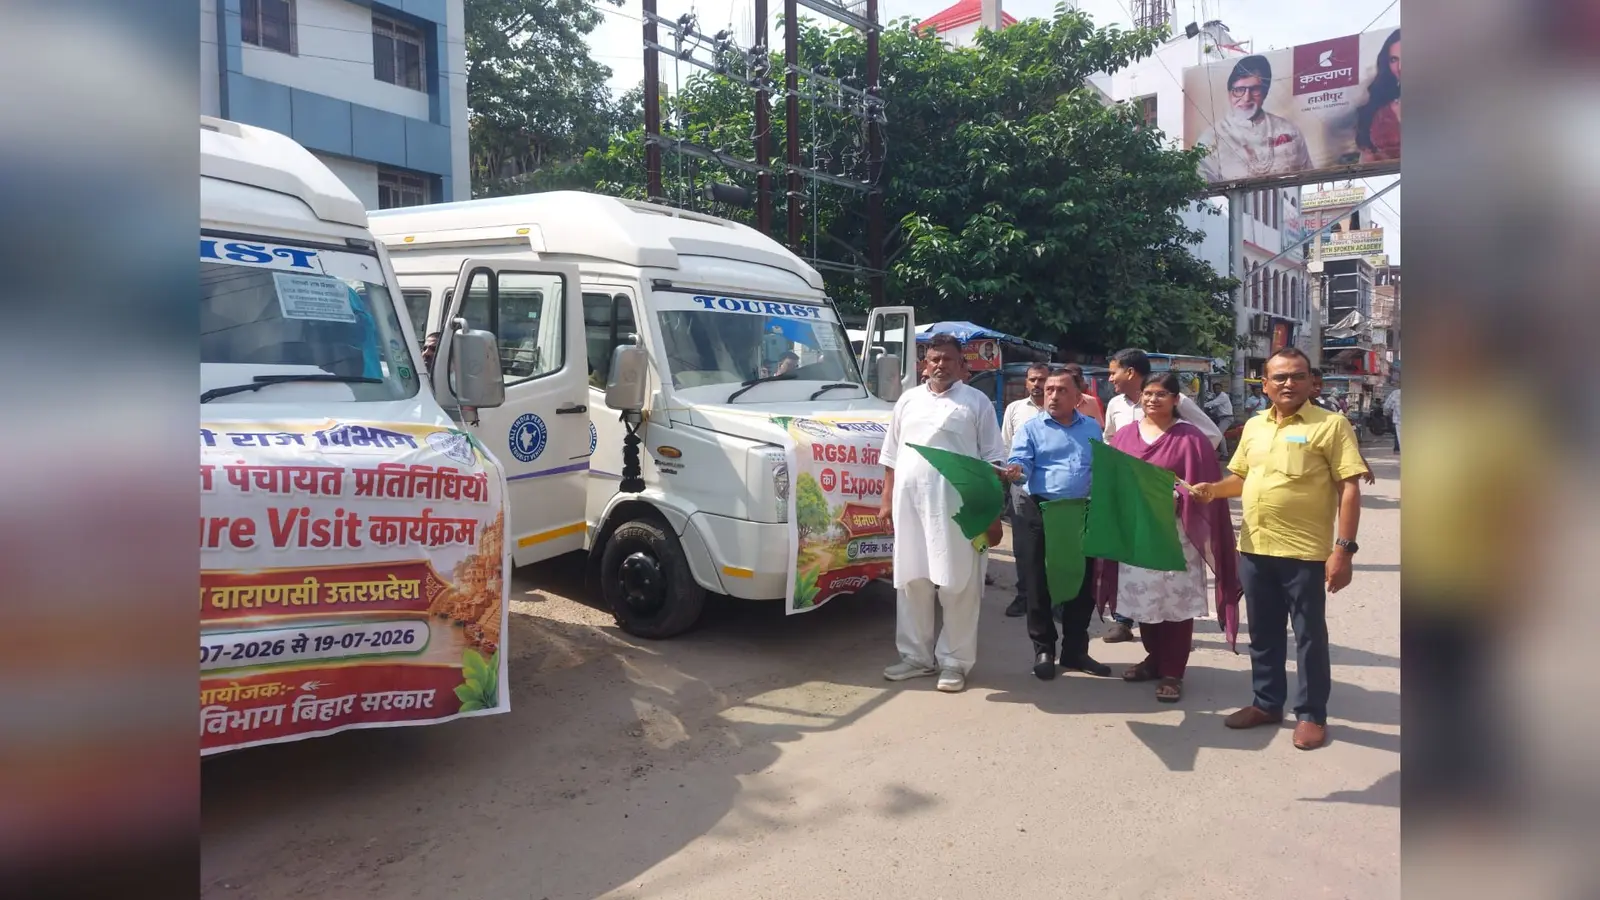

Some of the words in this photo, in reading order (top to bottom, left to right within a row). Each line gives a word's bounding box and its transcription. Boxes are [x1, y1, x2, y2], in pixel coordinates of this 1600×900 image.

[1300, 67, 1352, 84] कल्याण
[1356, 242, 1382, 251] ACADEMY
[694, 296, 820, 319] TOURIST
[226, 431, 304, 447] राज
[312, 425, 418, 449] विभाग
[509, 428, 517, 440] ALL
[514, 415, 530, 427] INDIA
[531, 415, 547, 436] PERMIT
[811, 443, 858, 464] RGSA
[861, 443, 881, 465] अंत
[223, 460, 345, 496] पंचायत
[841, 470, 885, 500] Expos
[267, 507, 362, 548] Visit
[368, 508, 478, 547] कार्यक्रम
[881, 543, 894, 553] 16-0
[211, 577, 320, 609] वाराणसी
[324, 574, 421, 604] उत्तरप्रदेश
[291, 633, 309, 653] से
[314, 629, 415, 651] 19-07-2026
[200, 704, 287, 737] विभाग
[292, 694, 357, 723] बिहार
[361, 689, 436, 712] सरकार
